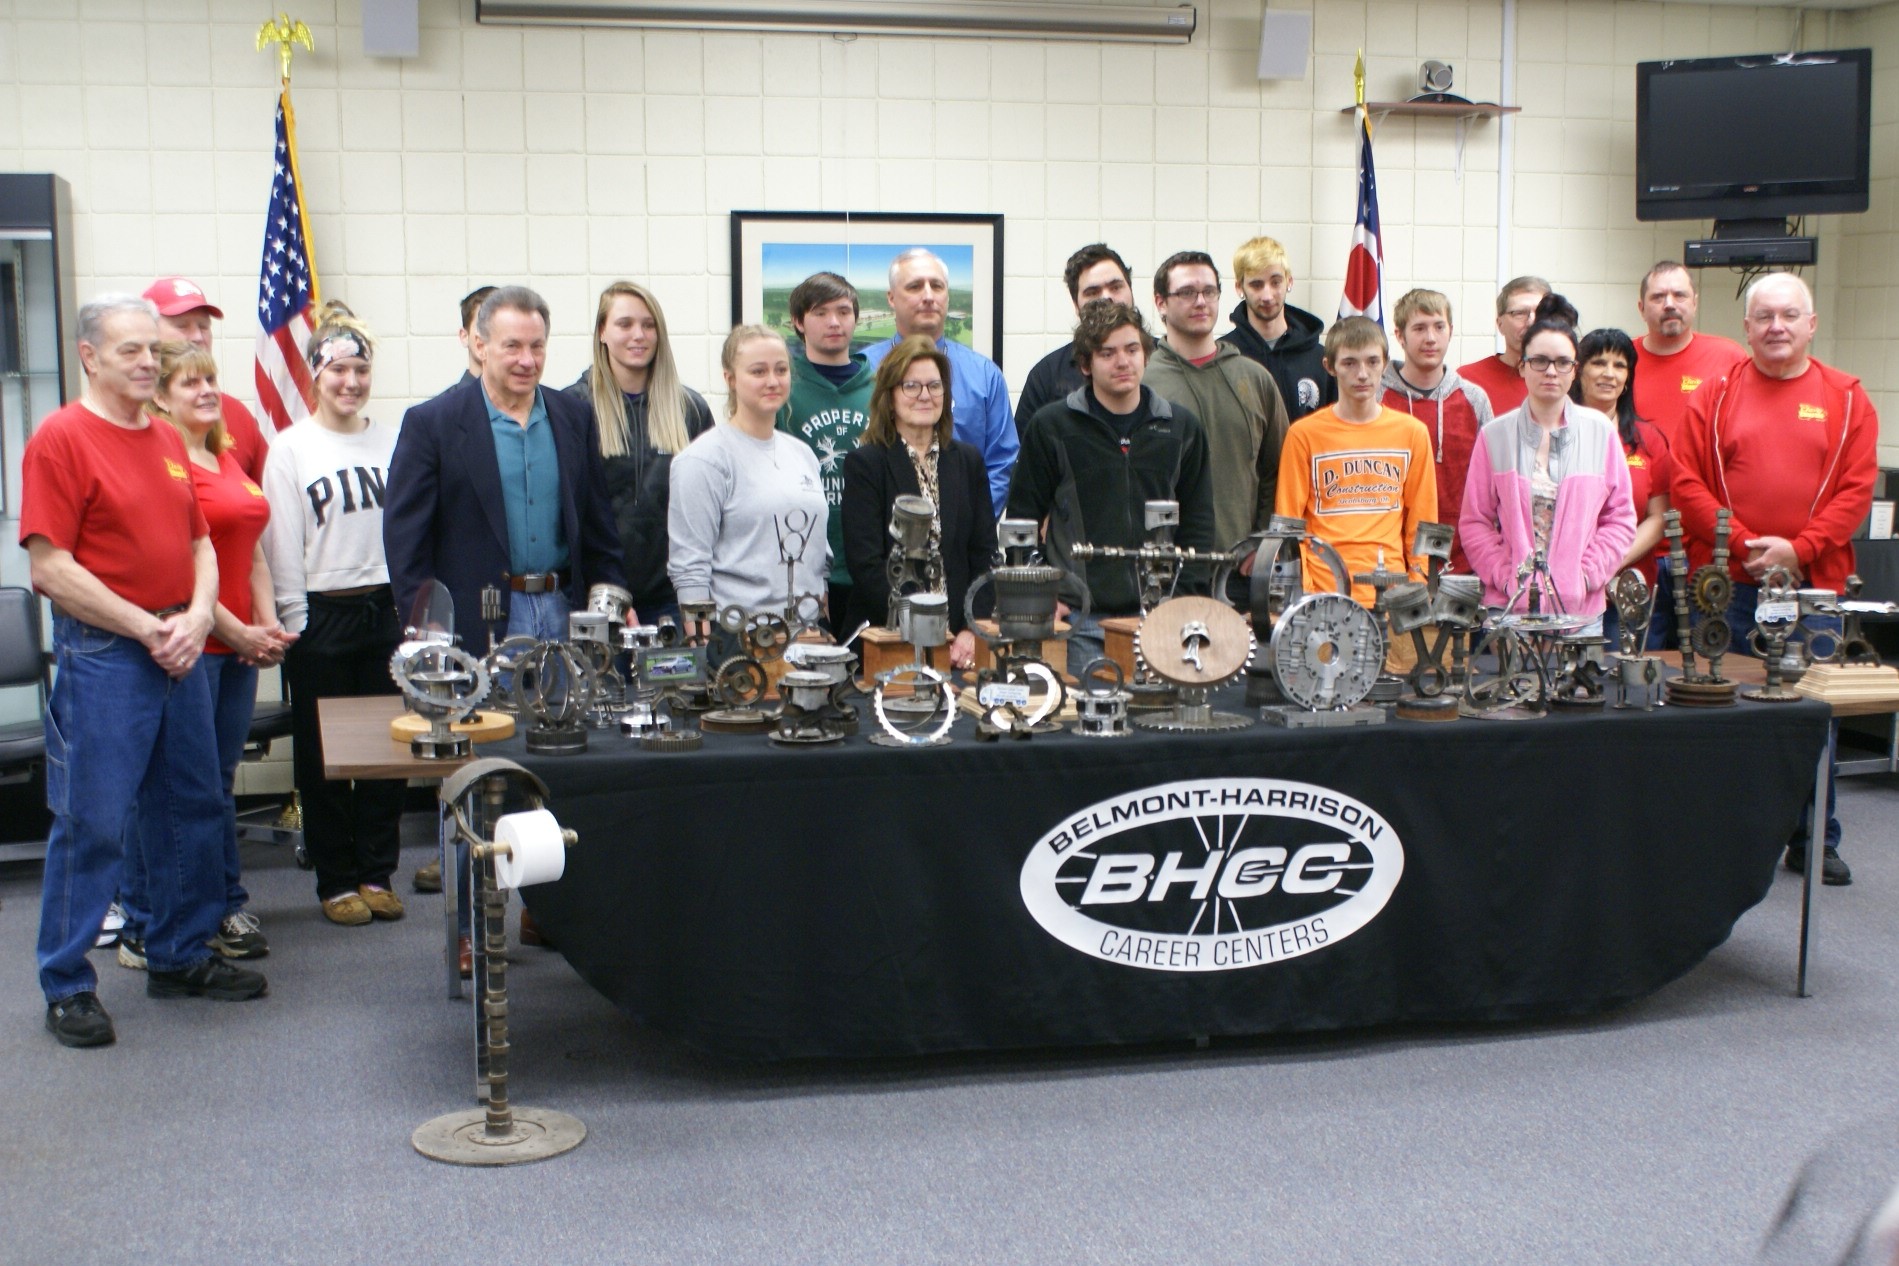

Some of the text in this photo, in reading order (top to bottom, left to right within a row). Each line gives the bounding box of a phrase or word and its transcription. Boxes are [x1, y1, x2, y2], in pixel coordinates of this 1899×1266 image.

[836, 426, 848, 436] OF
[306, 466, 390, 529] PIN
[1323, 459, 1401, 486] D. DUNCAN
[1326, 483, 1399, 498] Construction
[1048, 787, 1384, 856] BELMONT-HARRISON
[1080, 842, 1353, 905] BHCC
[1099, 917, 1330, 967] CAREER CENTERS
